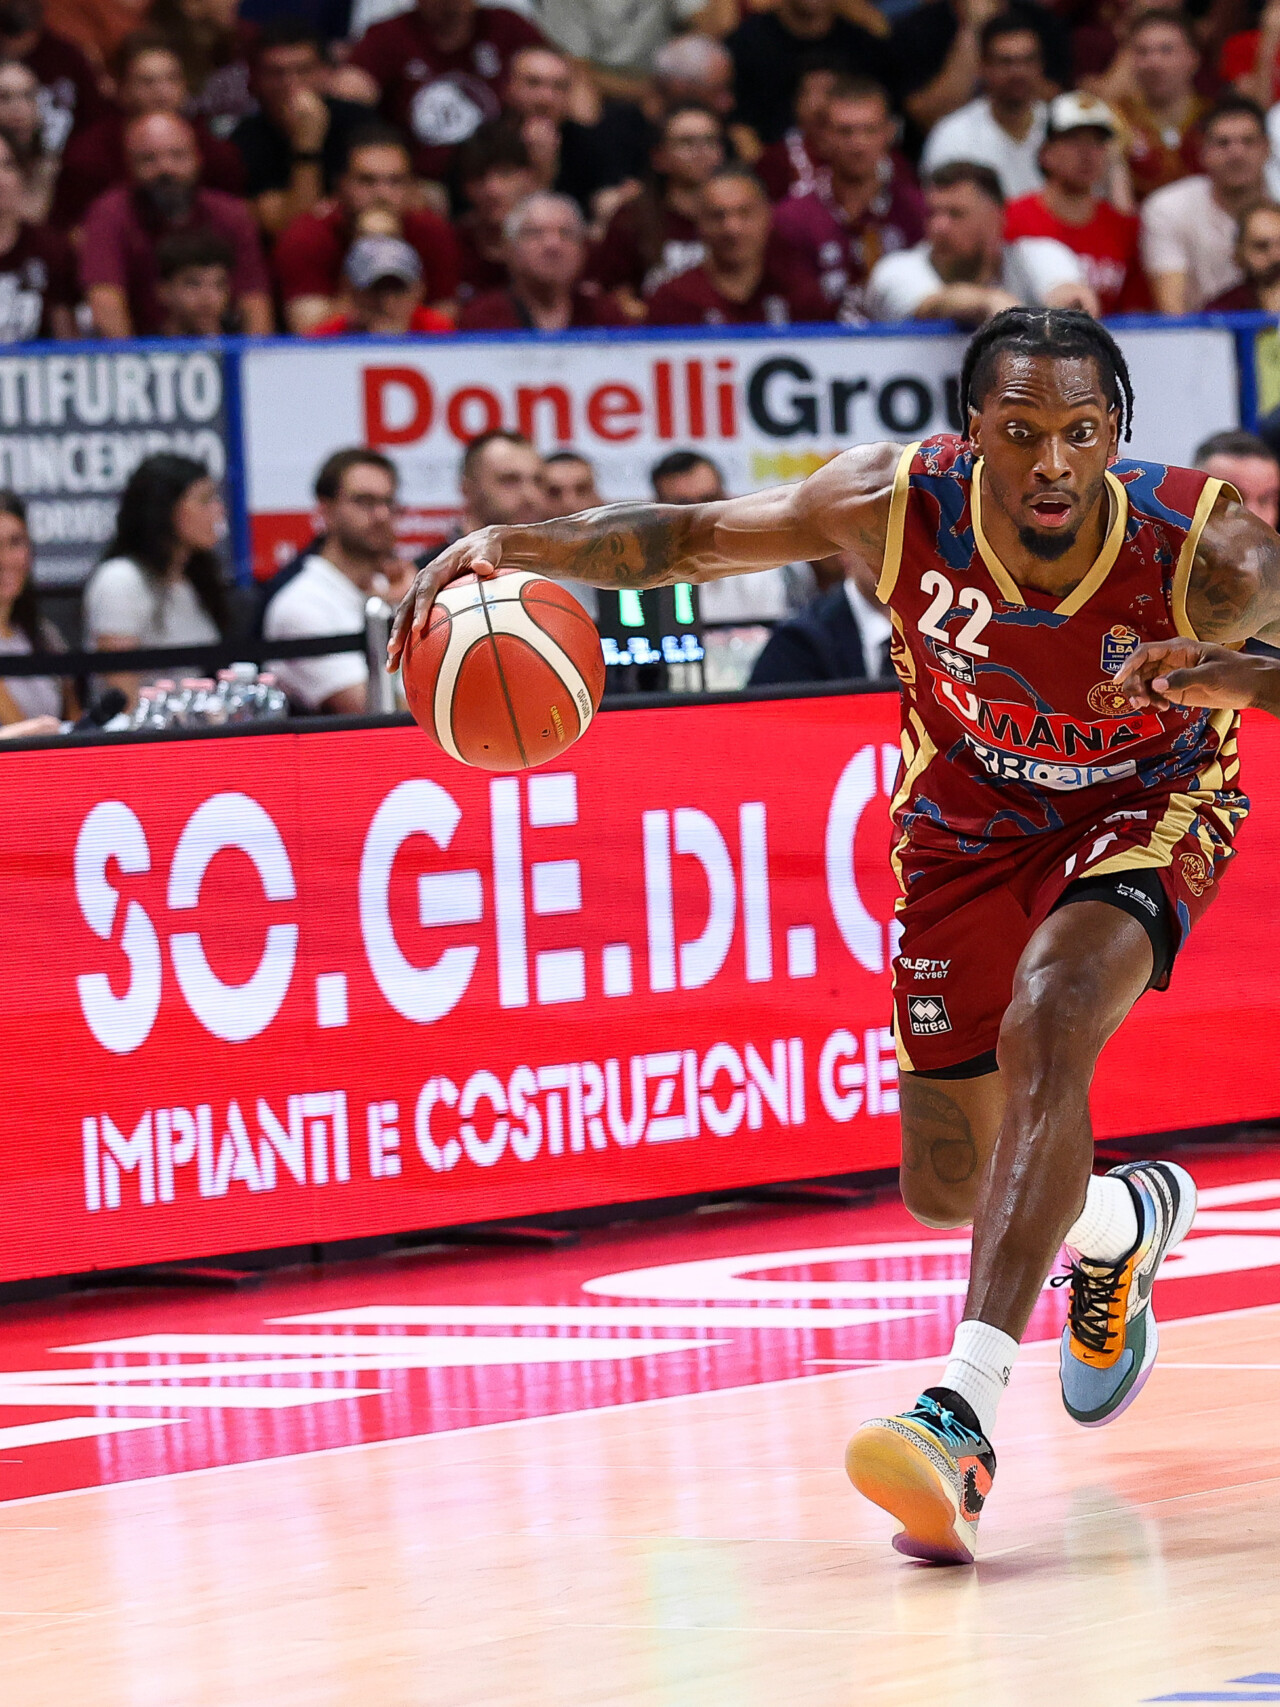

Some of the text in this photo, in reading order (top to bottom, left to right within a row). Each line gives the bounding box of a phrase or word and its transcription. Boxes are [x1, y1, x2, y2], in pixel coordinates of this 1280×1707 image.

[917, 570, 993, 658] 22
[940, 661, 972, 682] rrea
[1107, 644, 1134, 654] LBA
[941, 682, 1143, 756] UMANA
[912, 1019, 948, 1033] errea
[369, 1100, 401, 1176] E
[416, 1038, 804, 1171] COSTRUZIONI
